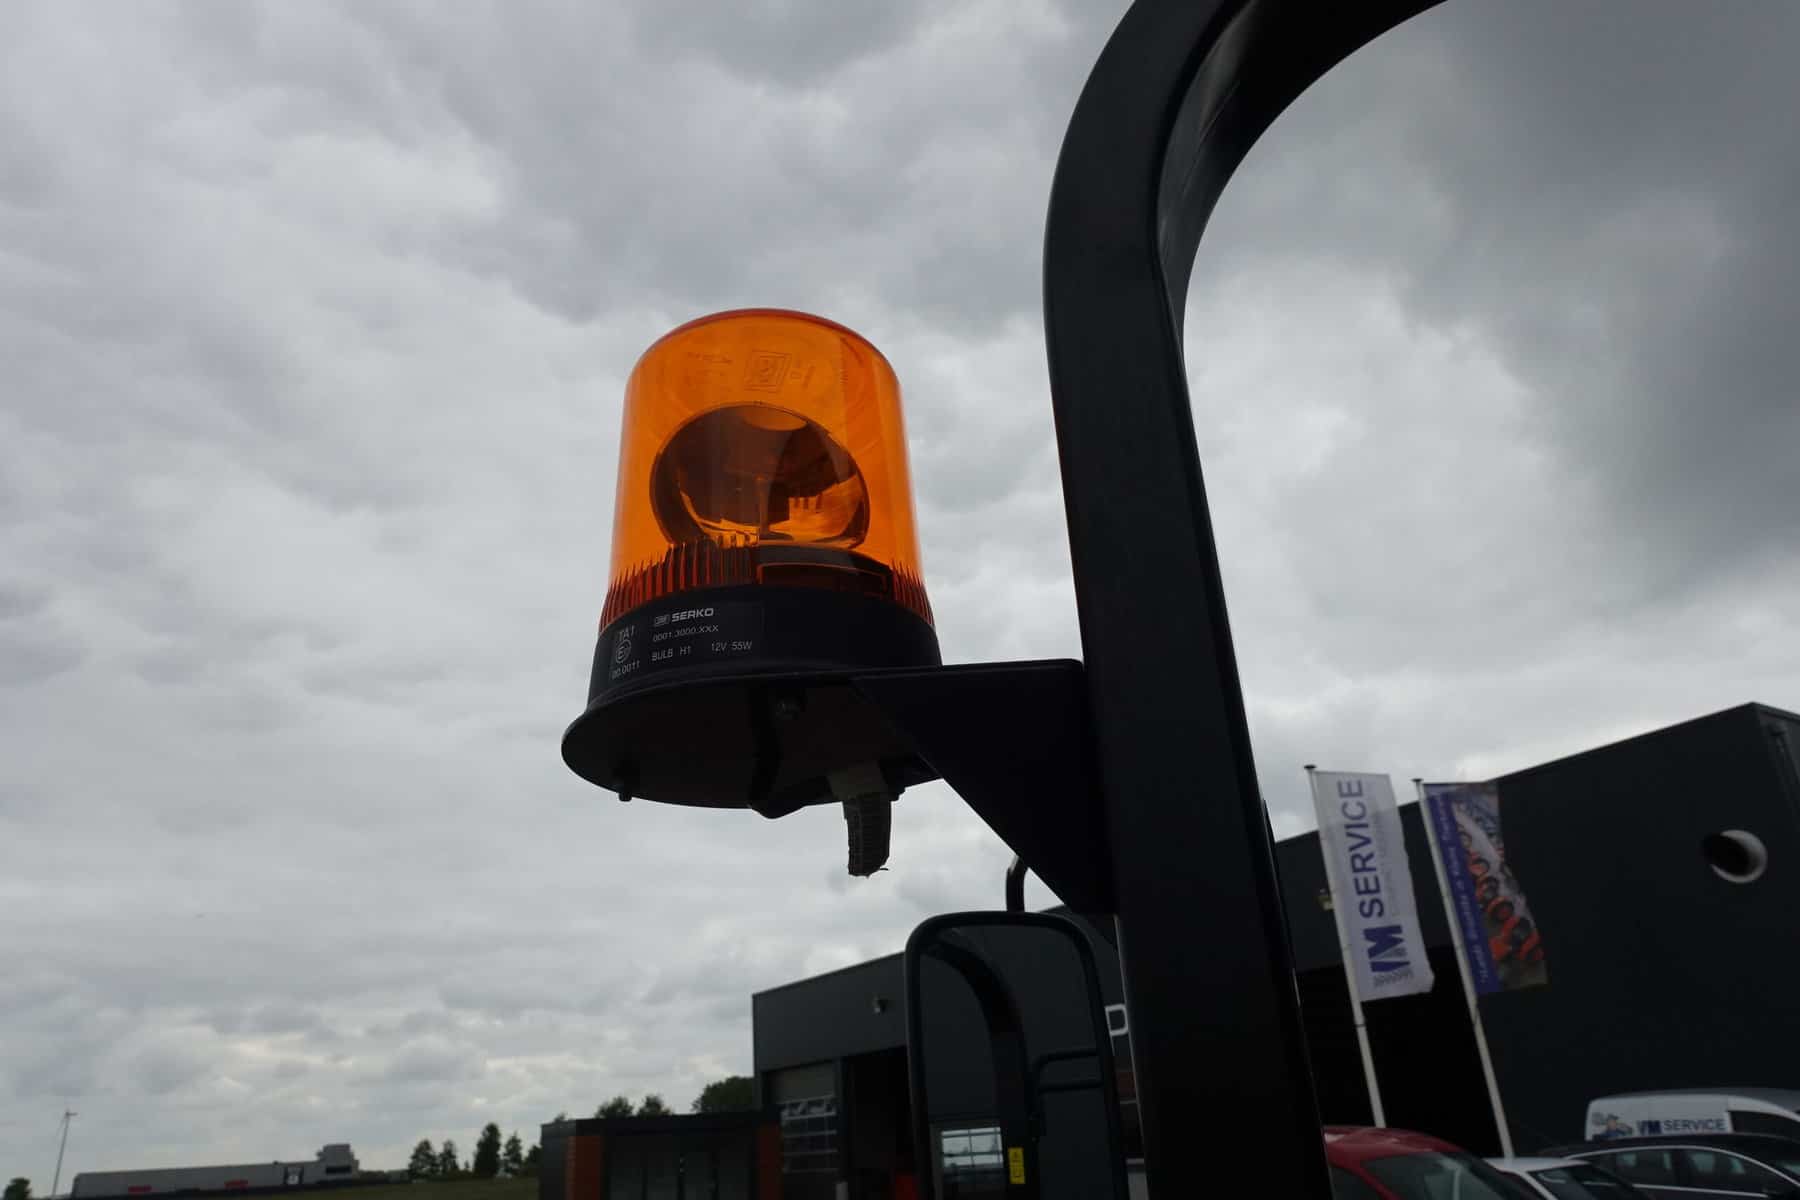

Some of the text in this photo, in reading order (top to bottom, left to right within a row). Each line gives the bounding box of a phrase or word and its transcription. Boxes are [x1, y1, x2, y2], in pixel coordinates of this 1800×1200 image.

[671, 607, 715, 623] SERKO
[651, 648, 674, 662] BULB
[712, 641, 729, 653] 12V
[732, 641, 754, 651] 55W
[1337, 779, 1385, 918] SERVICE
[1663, 1118, 1725, 1131] SERVICE
